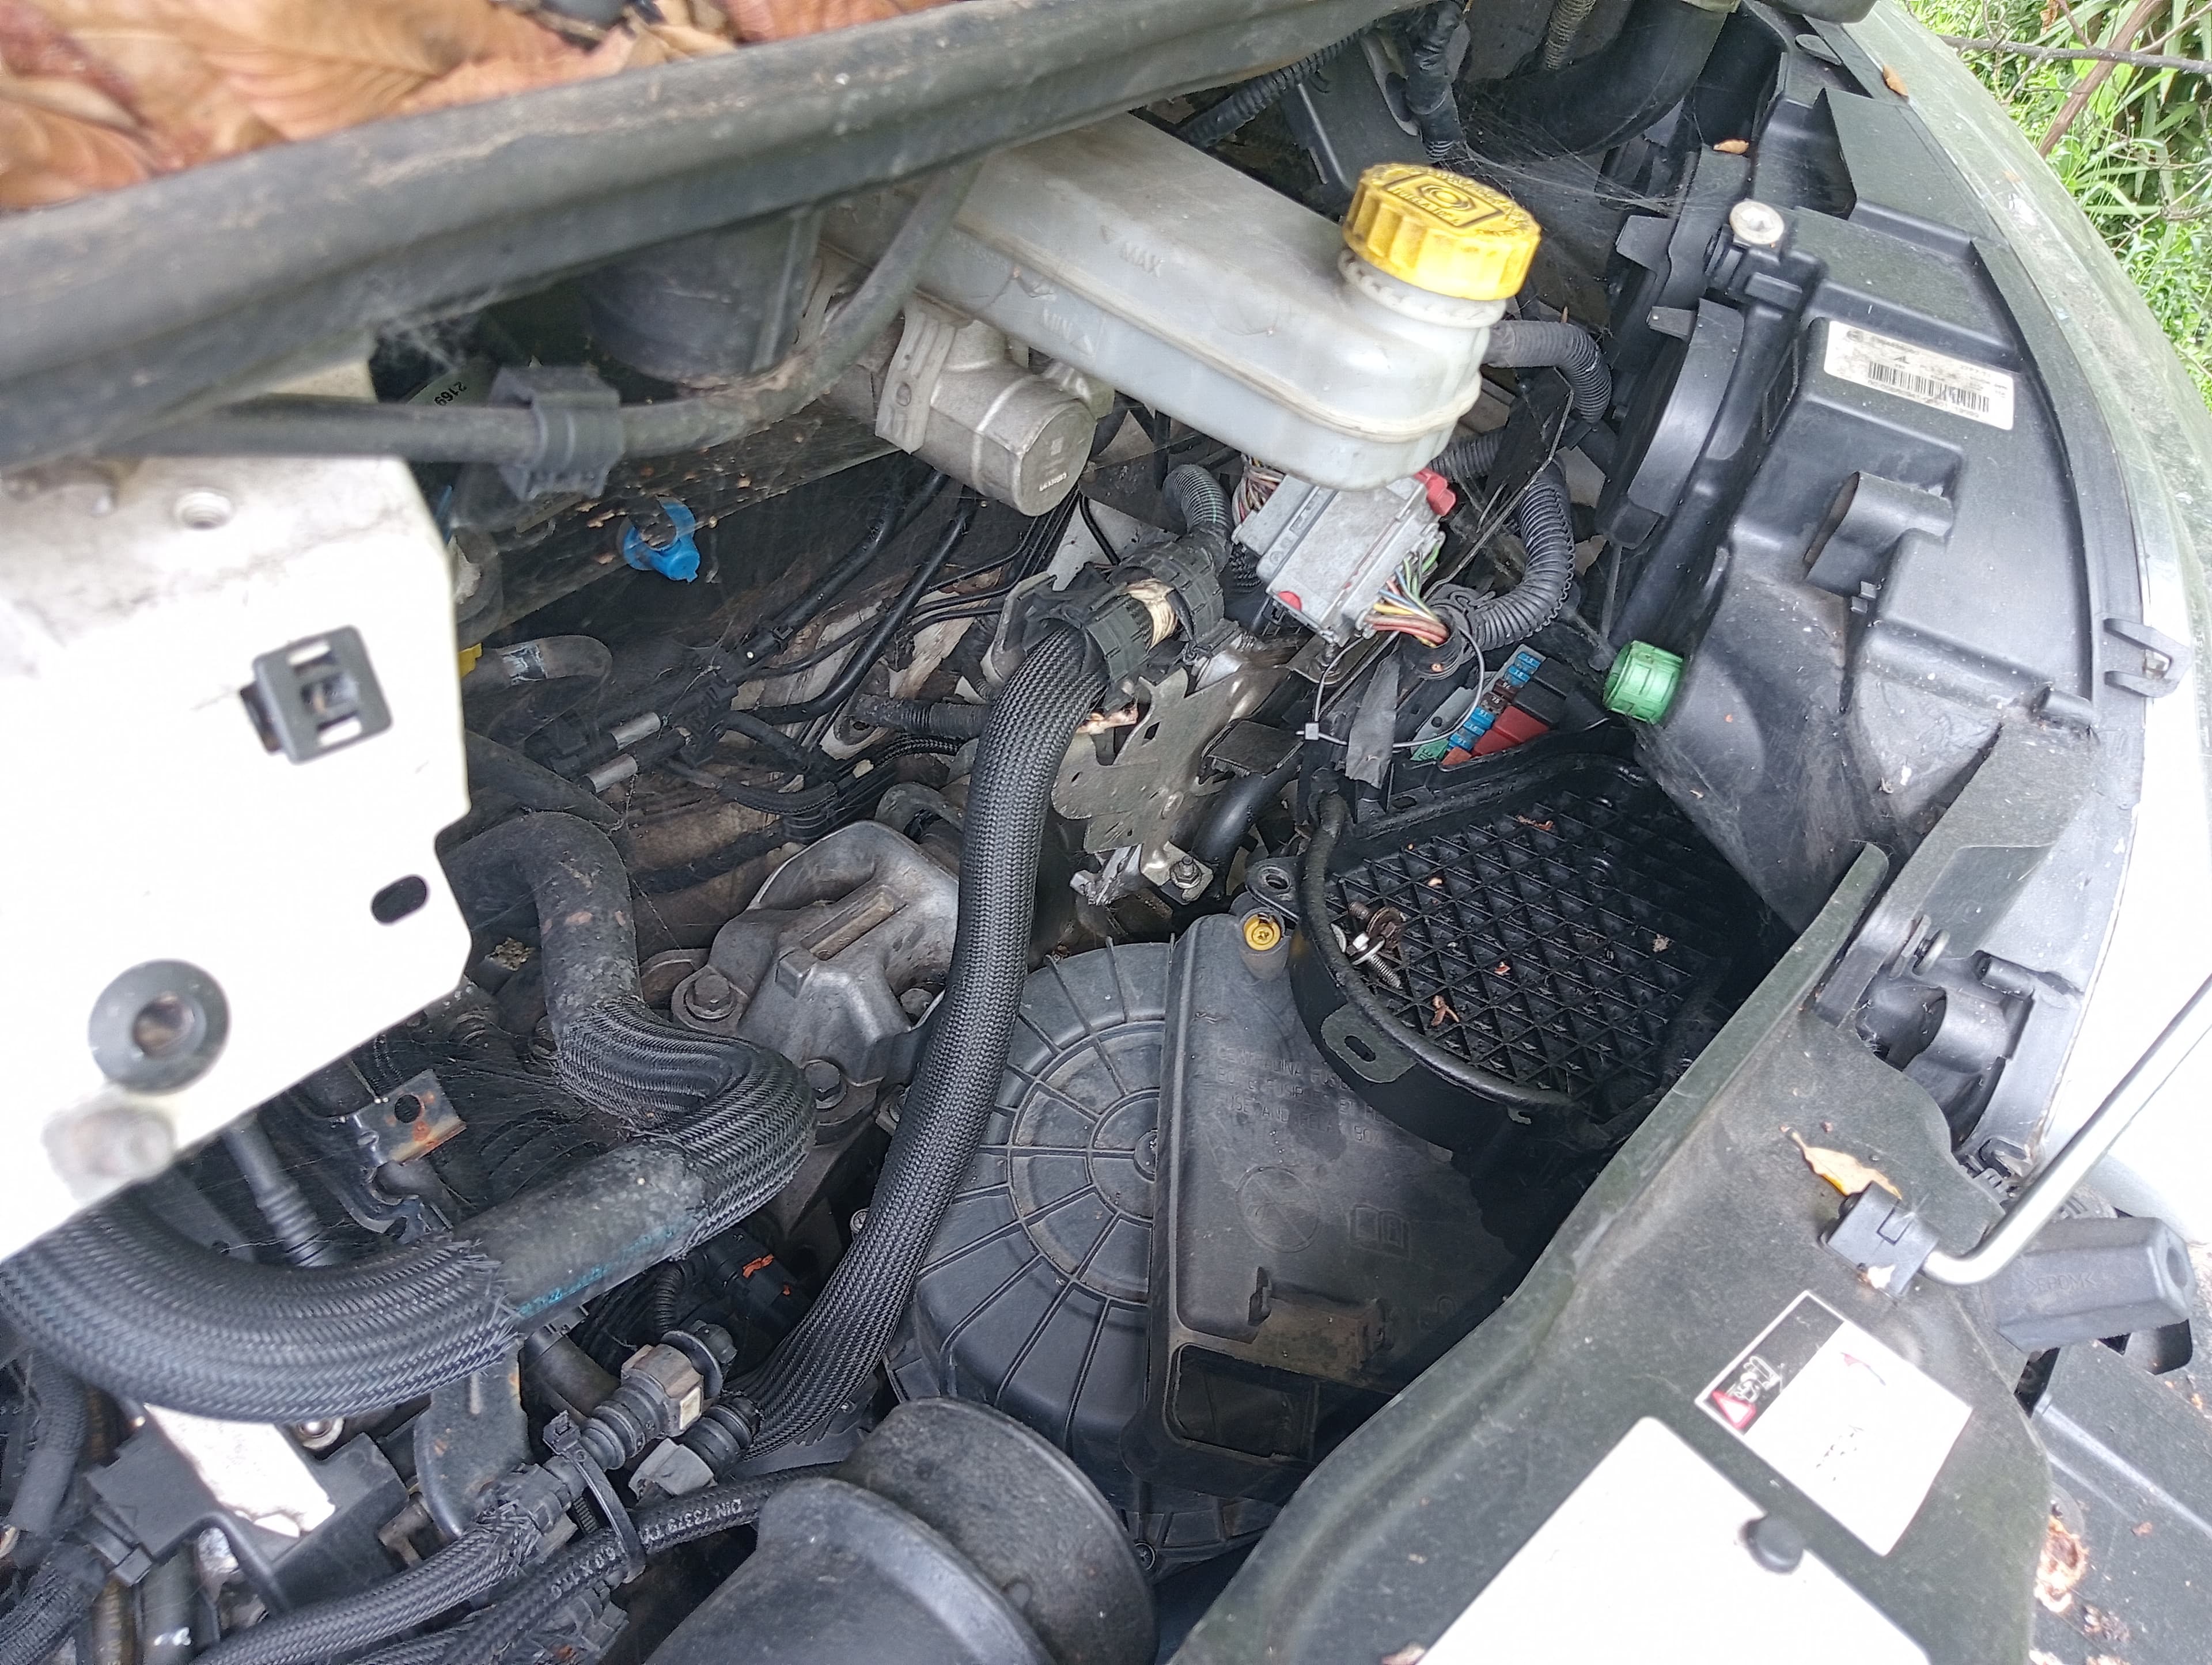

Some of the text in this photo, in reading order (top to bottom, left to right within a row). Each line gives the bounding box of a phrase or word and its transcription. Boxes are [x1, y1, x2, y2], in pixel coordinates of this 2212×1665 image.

[1120, 241, 1165, 278] MAX
[1042, 308, 1074, 340] MIN
[434, 381, 467, 405] 2169
[1261, 1103, 1290, 1122] AND
[1352, 1125, 1380, 1144] BOX
[715, 1498, 742, 1518] DIN
